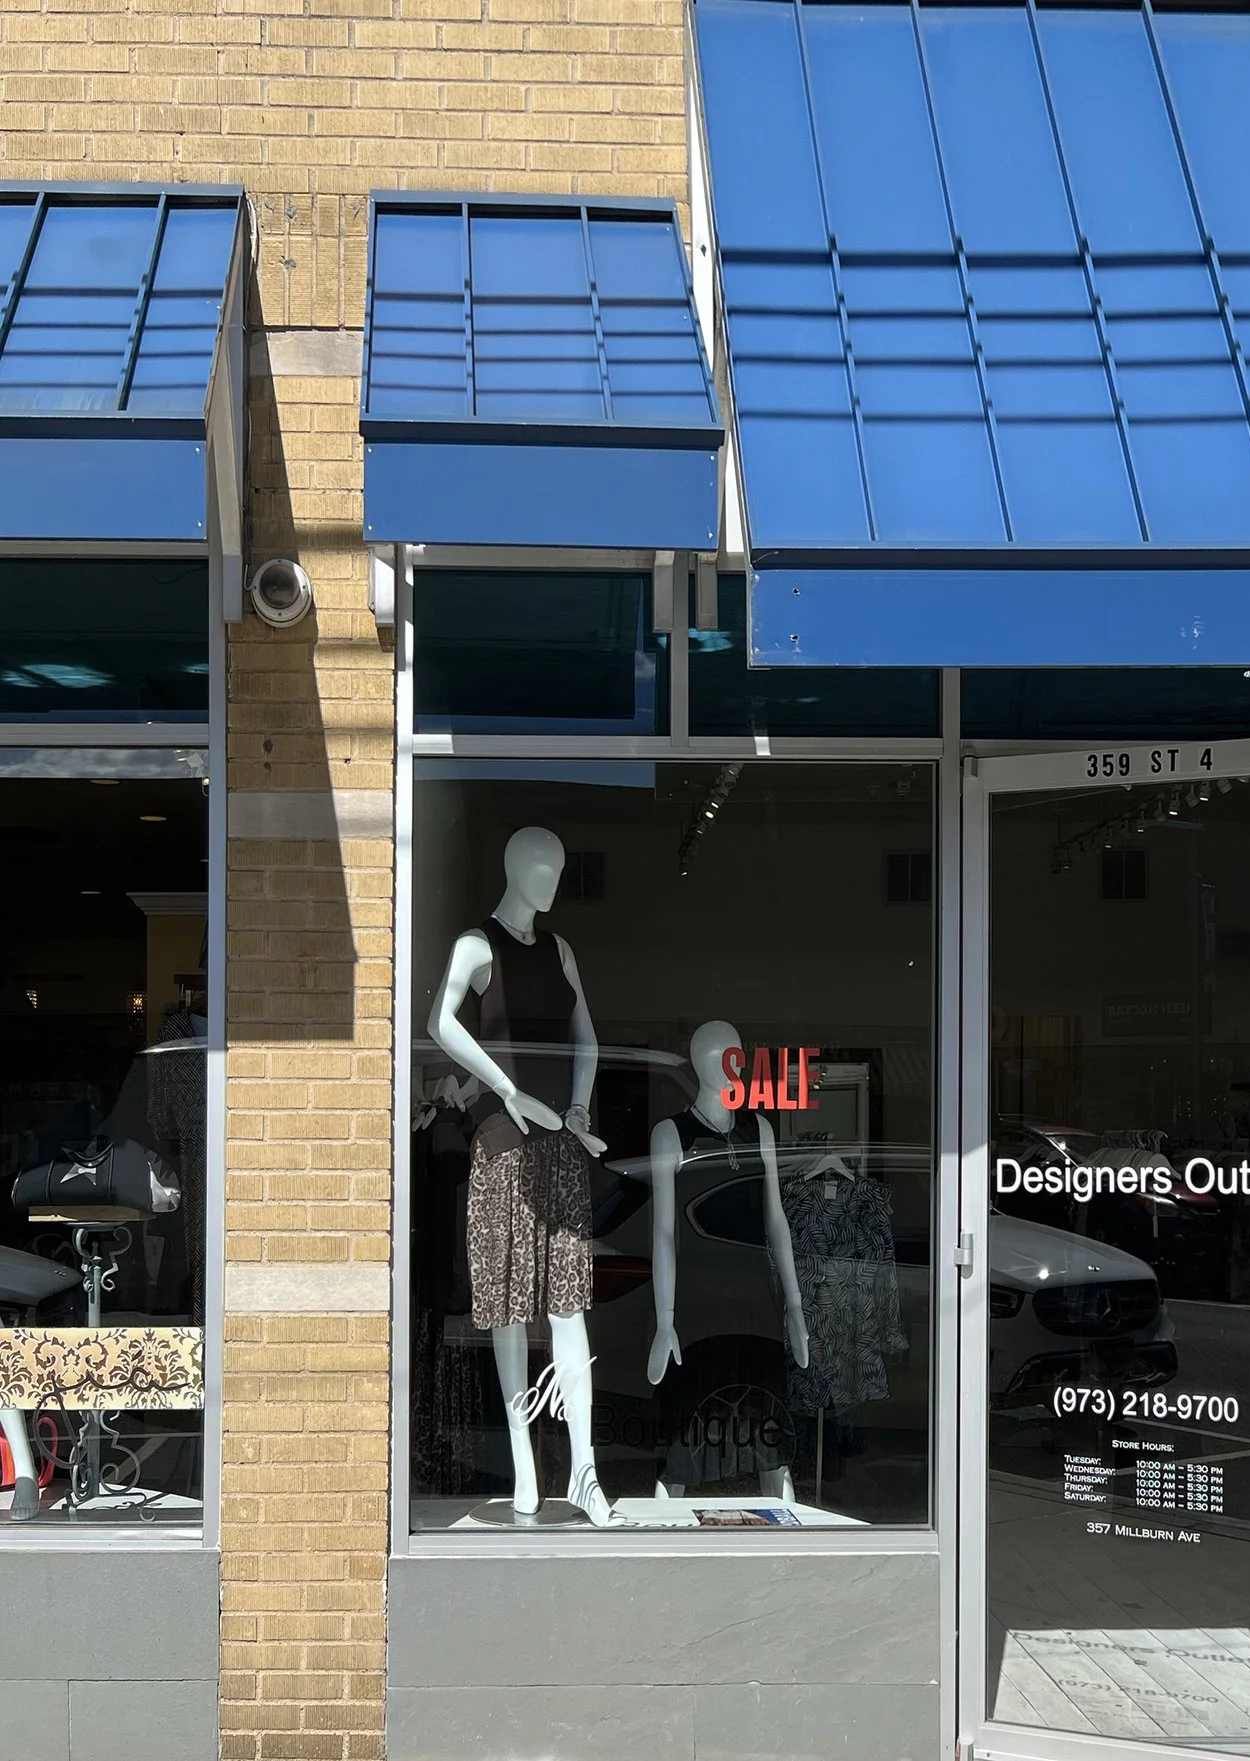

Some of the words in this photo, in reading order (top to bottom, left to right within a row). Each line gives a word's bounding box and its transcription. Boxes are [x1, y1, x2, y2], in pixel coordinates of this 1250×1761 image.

[1087, 753, 1130, 777] 359
[1151, 749, 1179, 773] ST
[1200, 748, 1212, 771] 4
[720, 1047, 820, 1110] SALE
[996, 1158, 1173, 1203] Designers
[1053, 1386, 1116, 1421] (973)
[1122, 1391, 1239, 1423] 218-9700
[590, 1403, 784, 1459] Boutique
[1136, 1460, 1161, 1469] 10:00
[1163, 1463, 1176, 1471] AM
[1187, 1464, 1208, 1473] 5:30
[1210, 1466, 1223, 1475] PM
[1136, 1469, 1161, 1479] 10:00
[1187, 1473, 1208, 1483] 5:30
[1210, 1476, 1223, 1484] PM
[1136, 1479, 1161, 1488] 10:00
[1187, 1483, 1208, 1492] 5:30
[1210, 1486, 1223, 1494] PM
[1136, 1488, 1161, 1497] 10:00
[1163, 1491, 1176, 1499] AM
[1187, 1492, 1208, 1502] 5:30
[1210, 1495, 1223, 1503] PM
[1136, 1498, 1161, 1507] 10:00
[1187, 1502, 1208, 1511] 5:30
[1210, 1505, 1223, 1513] PM
[1086, 1522, 1111, 1534] 357
[1115, 1525, 1174, 1541] MILLBURN
[1177, 1531, 1201, 1543] AVE
